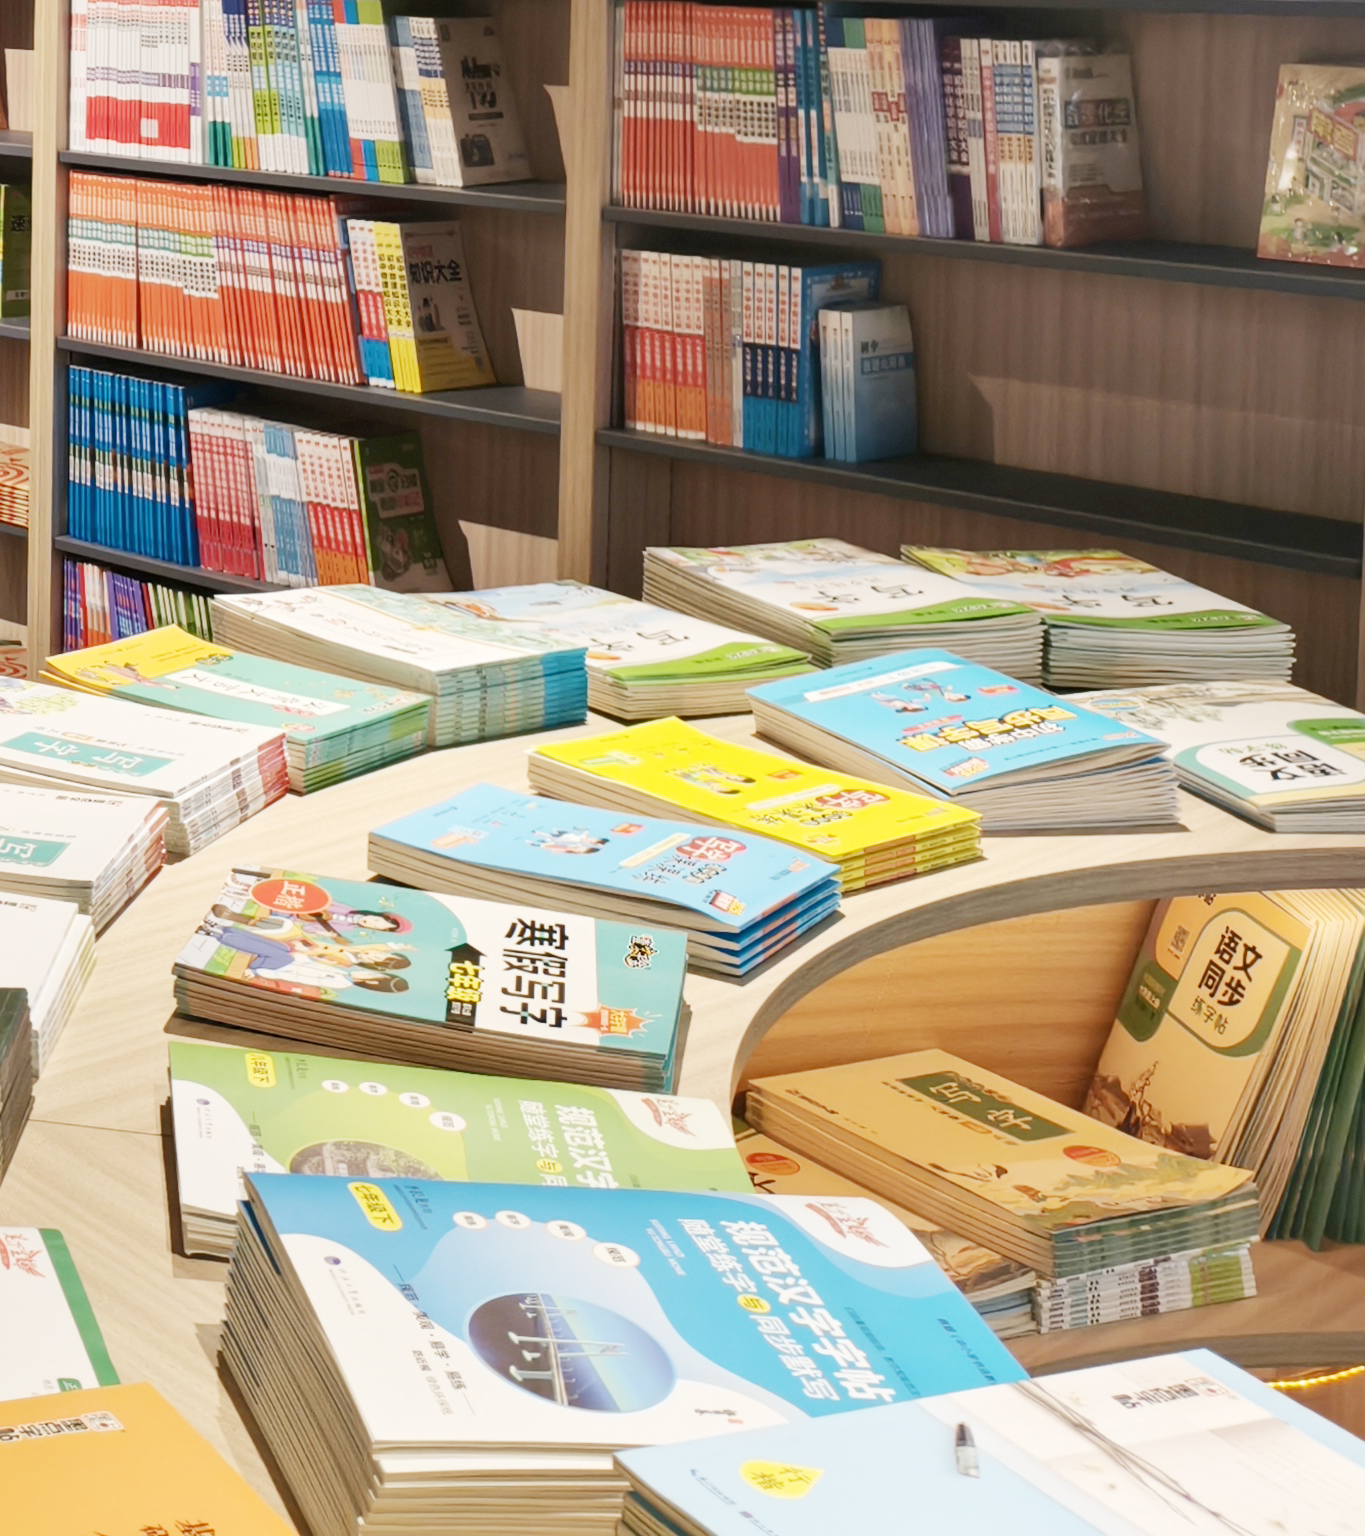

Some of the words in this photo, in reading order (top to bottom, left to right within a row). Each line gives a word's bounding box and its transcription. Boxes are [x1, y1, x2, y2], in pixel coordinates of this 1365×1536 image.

[409, 260, 463, 284] 知识大全
[897, 705, 1077, 753] 同步写字课
[34, 738, 144, 769] 写字
[1255, 762, 1346, 782] 语文
[275, 880, 306, 910] 正楷
[500, 917, 569, 1029] 寒假写字
[1213, 926, 1264, 983] 语文
[446, 960, 484, 1005] 七年级
[1197, 960, 1247, 1007] 同步
[1191, 996, 1229, 1035] 练字帖
[248, 1053, 273, 1085] 八年级下
[351, 1184, 395, 1227] 七年级下
[678, 1218, 839, 1401] 随堂练字与同步默写
[721, 1220, 895, 1404] 规范汉字字帖
[751, 1466, 812, 1491] 行楷
